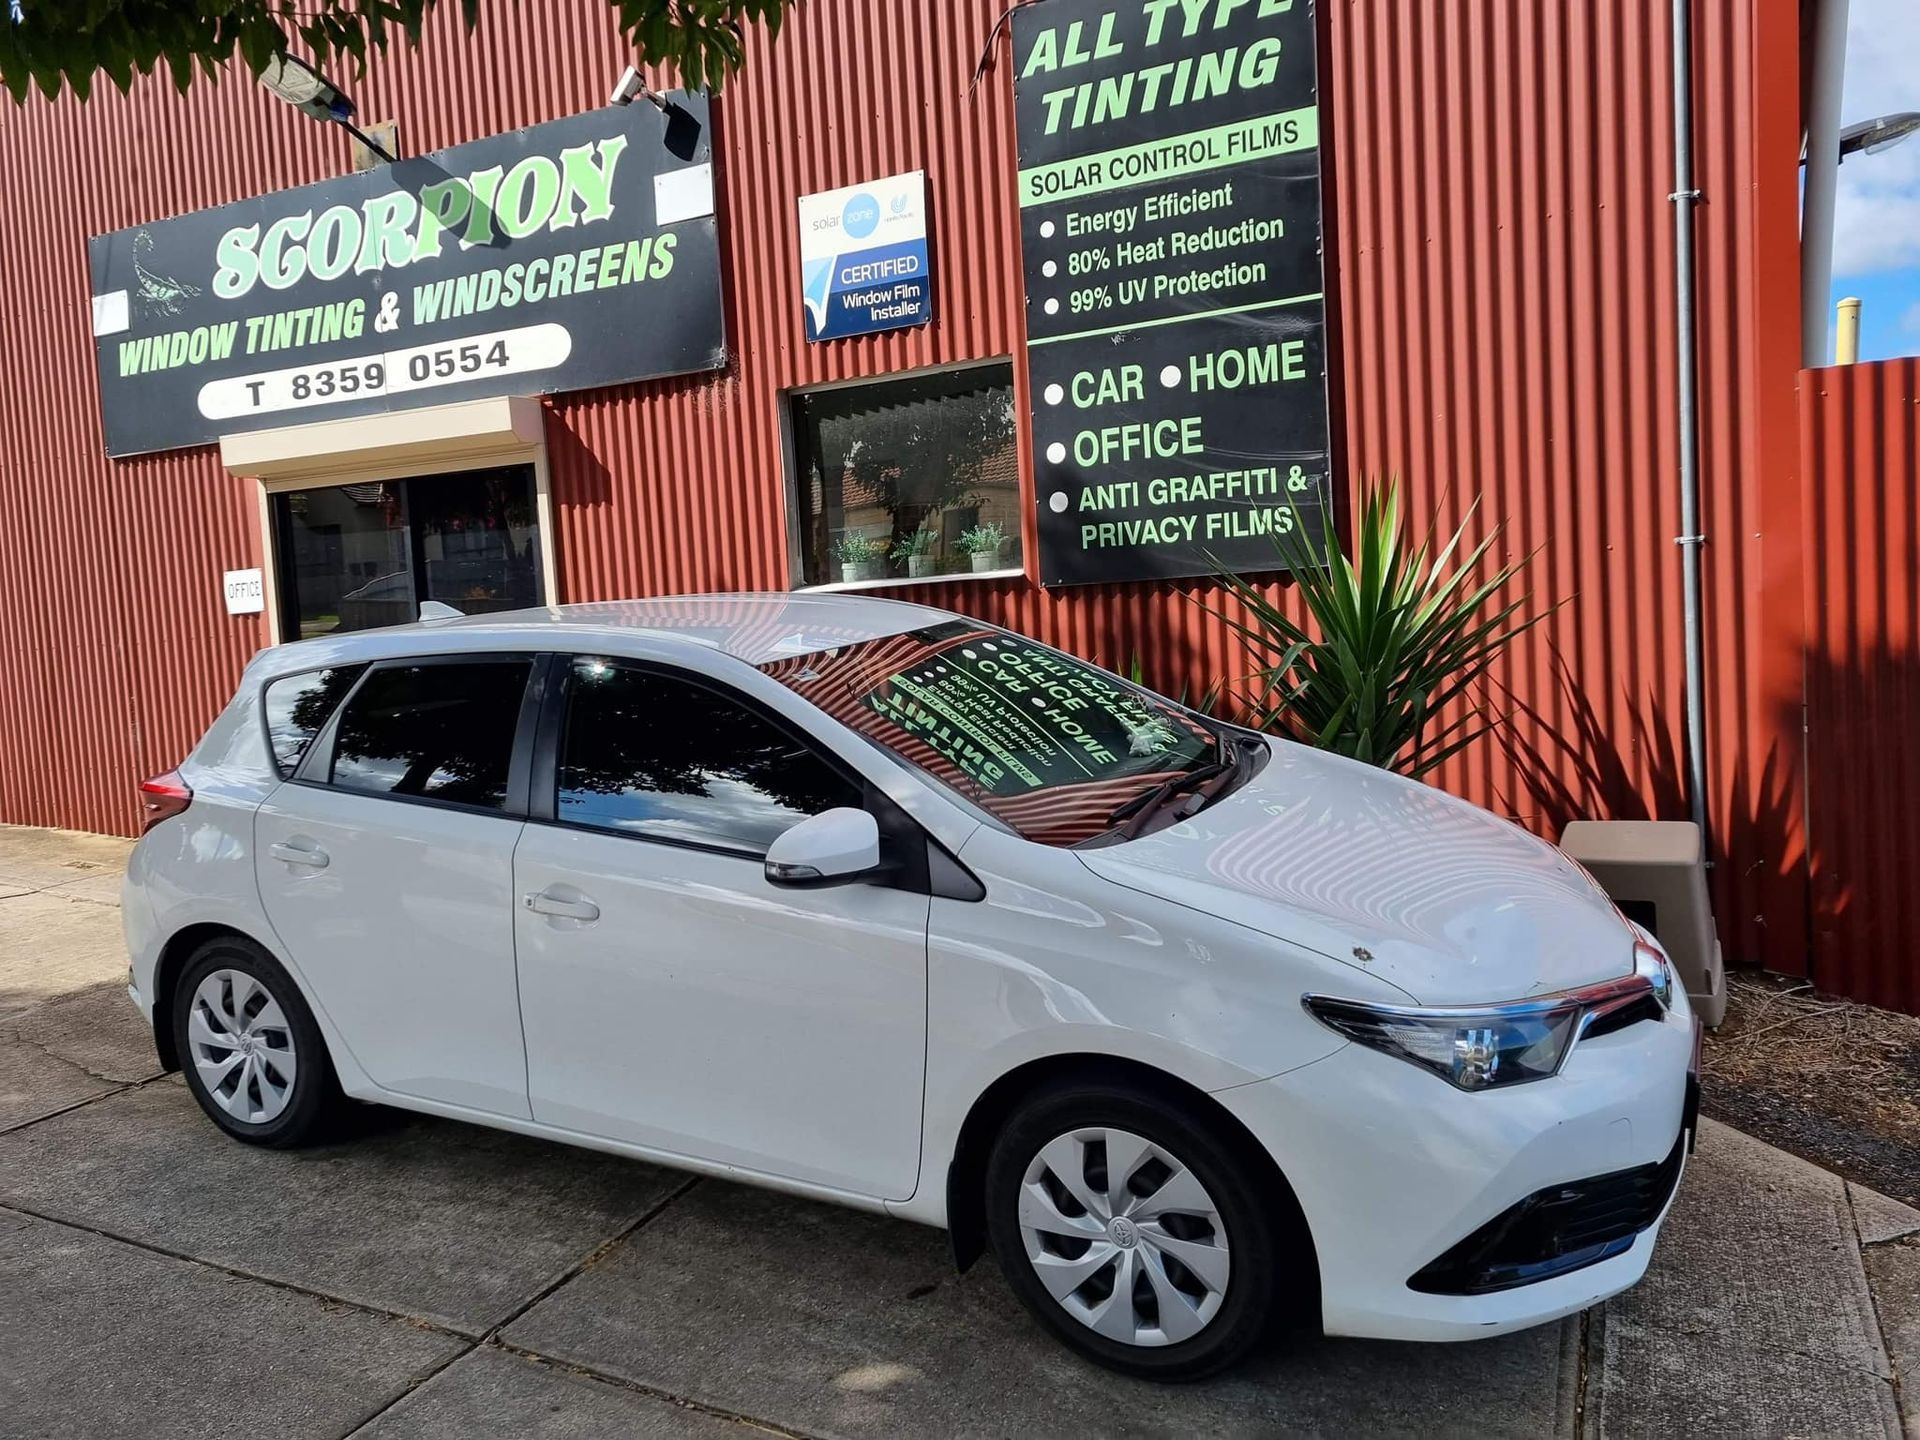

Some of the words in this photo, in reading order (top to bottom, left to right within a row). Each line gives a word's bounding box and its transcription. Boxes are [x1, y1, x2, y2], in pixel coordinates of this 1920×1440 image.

[1021, 12, 1124, 79] ALL
[1042, 37, 1281, 135] TINTING
[1031, 163, 1102, 197] SOLAR
[1109, 138, 1220, 180] CONTROL
[1227, 120, 1299, 156] FILMS
[212, 134, 628, 299] SCORPION
[812, 214, 841, 231] solar
[847, 208, 874, 224] zone
[1066, 206, 1138, 237] Energy
[1145, 182, 1233, 221] Efficient
[841, 255, 919, 285] CERTIFIED
[1068, 247, 1110, 276] 80%
[1117, 237, 1165, 266] Heat
[1171, 218, 1284, 257] Reduction
[119, 322, 237, 378] WINDOW
[245, 298, 366, 356] TINTING
[377, 292, 401, 333] &
[413, 233, 678, 326] WINDSCREENS
[842, 292, 892, 309] Window
[894, 285, 920, 300] Film
[871, 302, 921, 321] Installer
[1070, 286, 1112, 313] 99%
[1118, 278, 1147, 305] UV
[1154, 263, 1266, 299] Protection
[246, 381, 265, 407] T
[291, 363, 385, 400] 8359
[408, 339, 510, 383] 0554
[1071, 364, 1145, 409] CAR
[1189, 340, 1306, 393] HOME
[1073, 416, 1204, 467] OFFICE
[1079, 482, 1139, 512] ANTI
[1148, 468, 1277, 505] GRAFFITI
[1287, 465, 1308, 492] &
[1081, 515, 1198, 550] PRIVACY
[1206, 507, 1294, 539] FILMS
[228, 581, 261, 599] OFFICE
